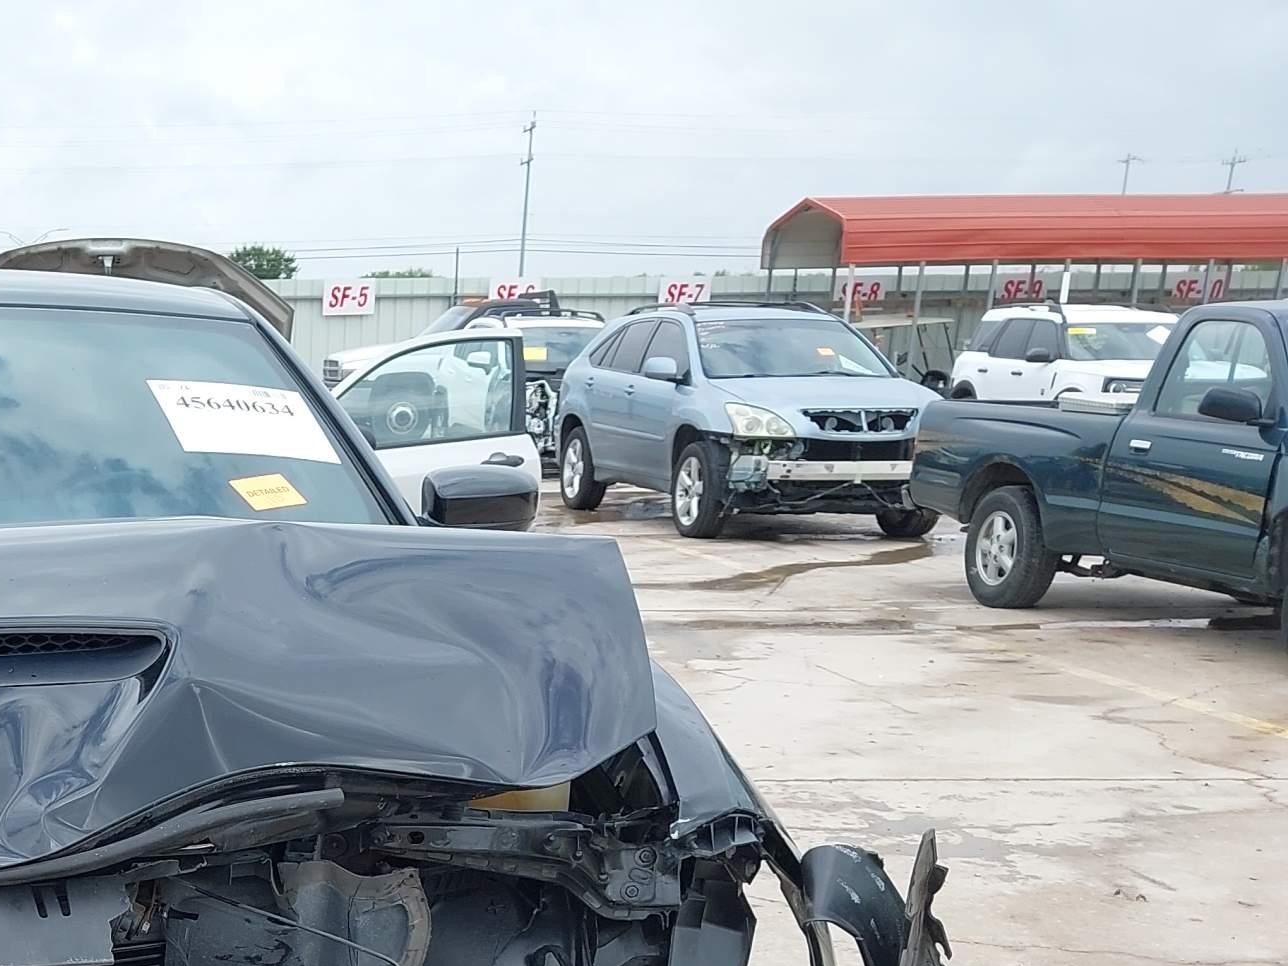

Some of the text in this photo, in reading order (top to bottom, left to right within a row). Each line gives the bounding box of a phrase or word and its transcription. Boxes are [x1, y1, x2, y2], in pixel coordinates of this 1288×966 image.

[328, 285, 370, 308] SF-5
[497, 284, 535, 299] SF
[664, 283, 705, 303] SF-7
[1173, 279, 1223, 298] SF-0
[175, 395, 295, 417] 45640634
